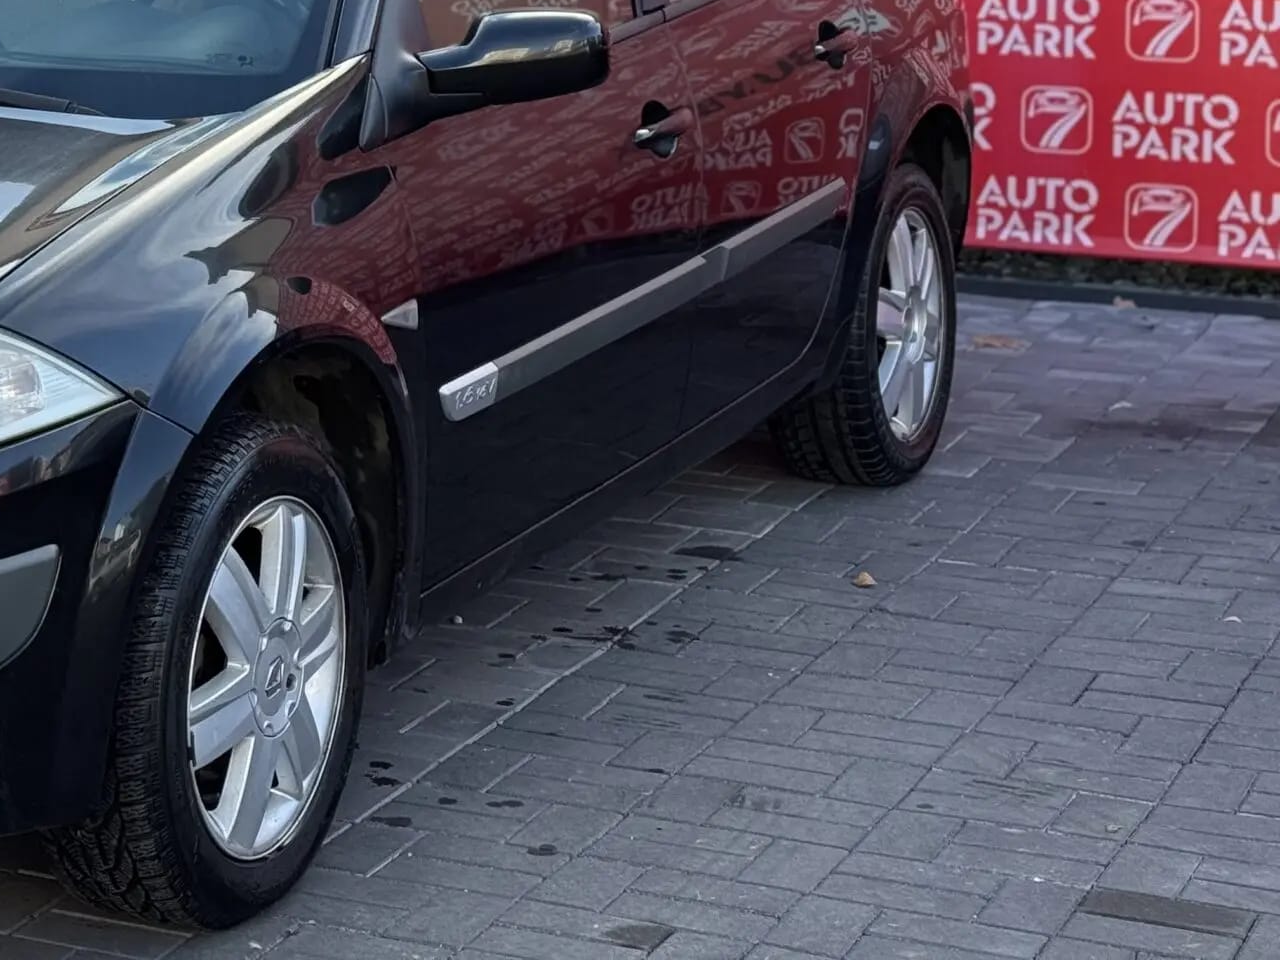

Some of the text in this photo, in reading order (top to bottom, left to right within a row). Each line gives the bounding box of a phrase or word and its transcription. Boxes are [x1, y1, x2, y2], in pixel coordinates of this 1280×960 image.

[977, 22, 1096, 60] PARK
[1112, 90, 1239, 129] AUTO
[1112, 123, 1235, 165] PARK
[976, 175, 1099, 213] AUTO
[976, 208, 1094, 247] PARK
